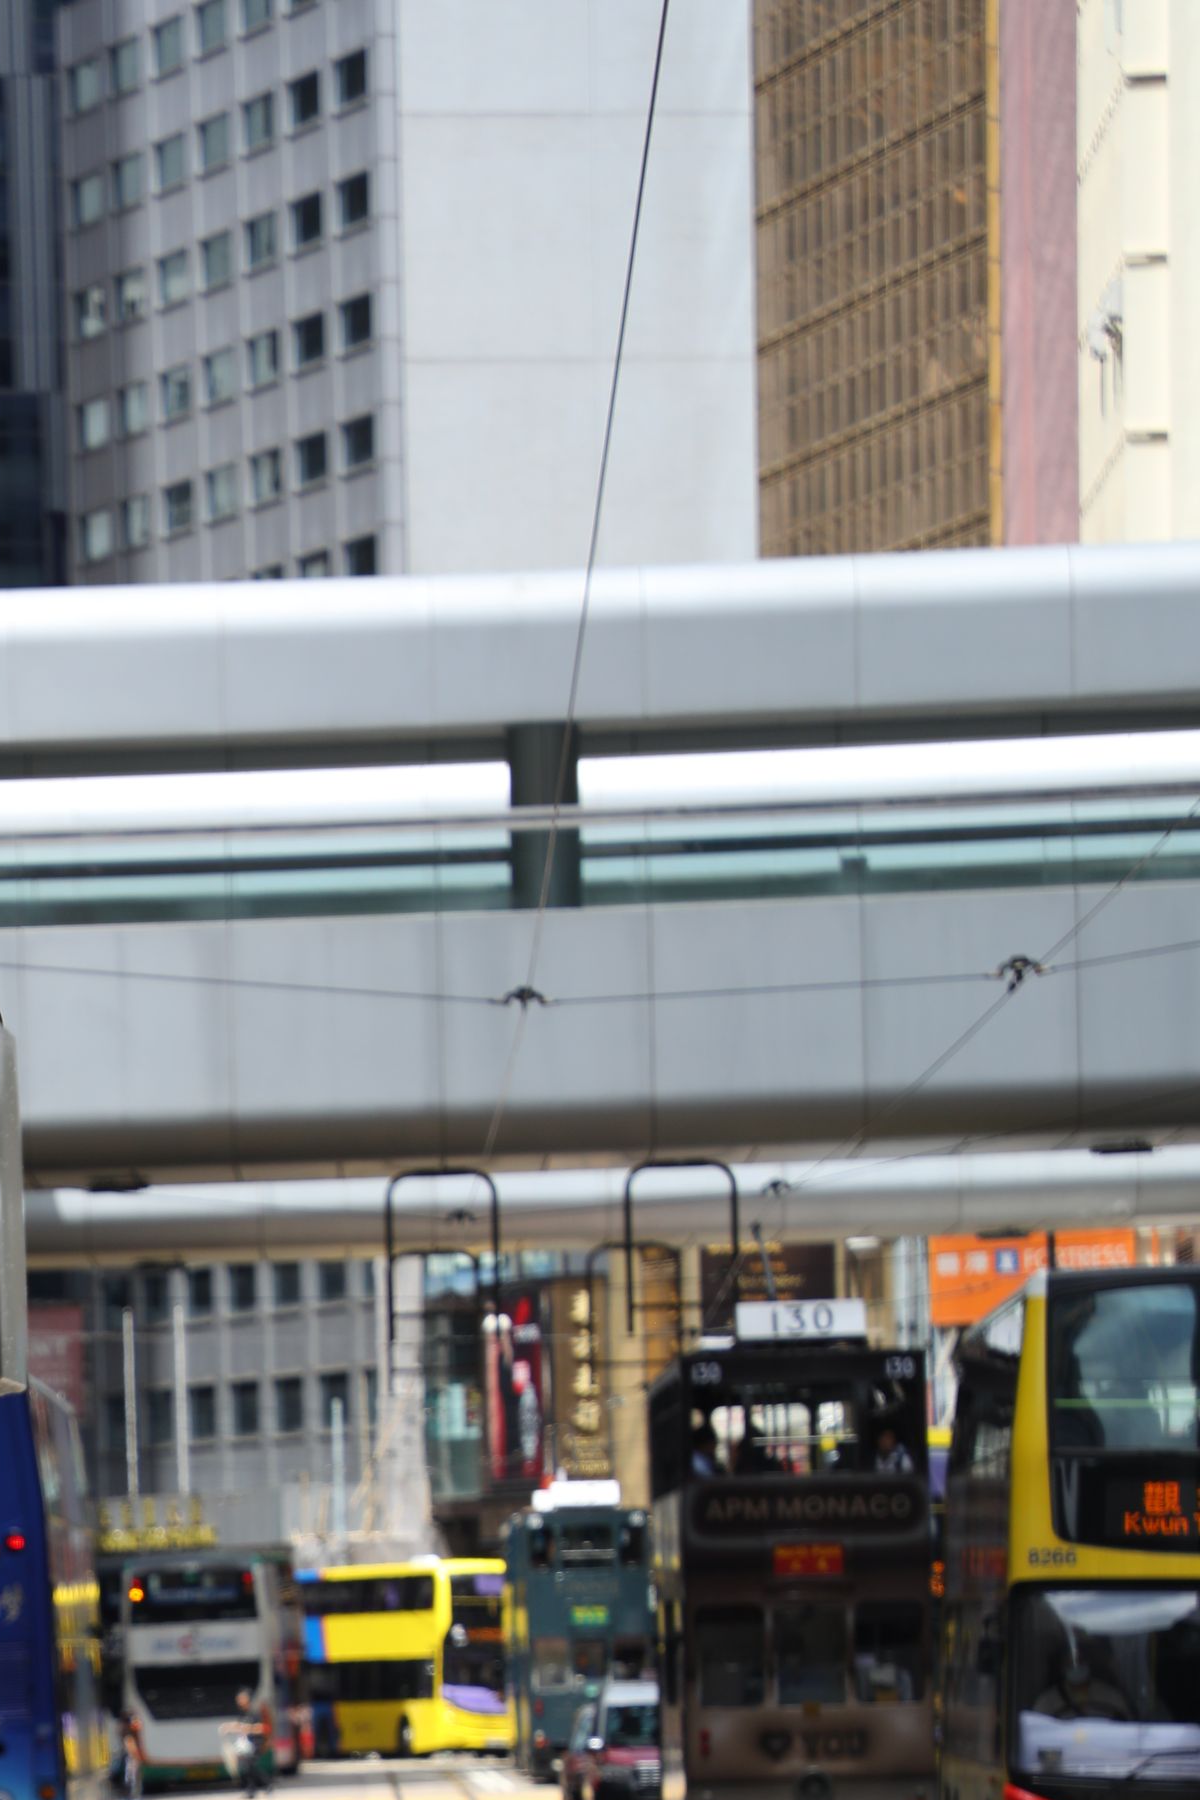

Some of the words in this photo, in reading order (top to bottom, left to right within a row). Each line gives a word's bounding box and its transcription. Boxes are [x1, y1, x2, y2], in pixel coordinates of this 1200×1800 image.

[771, 1304, 834, 1333] 130
[691, 1361, 722, 1384] 130
[885, 1355, 916, 1380] 130
[705, 1495, 769, 1521] APM
[776, 1493, 913, 1520] MONACO
[1124, 1511, 1188, 1537] Kwun
[804, 1729, 868, 1757] YOU
